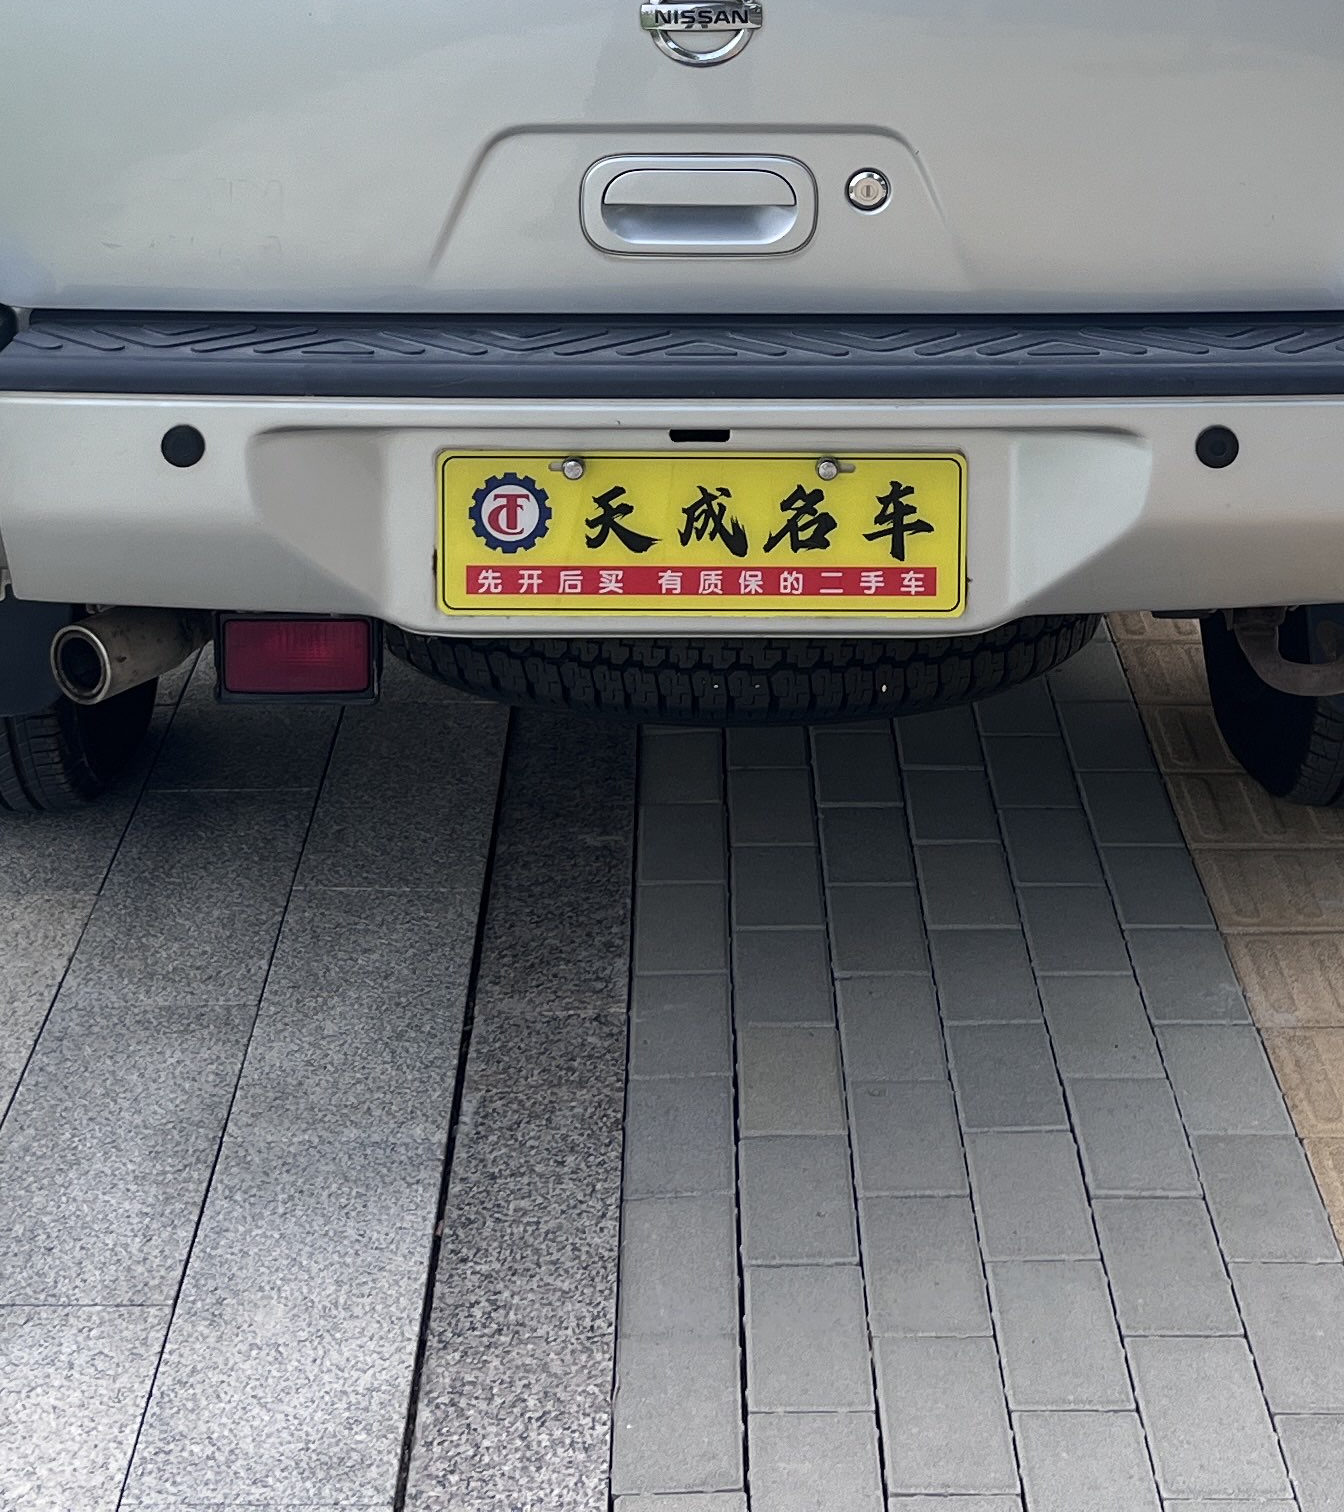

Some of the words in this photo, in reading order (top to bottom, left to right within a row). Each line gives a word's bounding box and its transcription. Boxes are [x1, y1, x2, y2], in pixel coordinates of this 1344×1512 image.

[655, 9, 749, 25] NISSAN
[584, 480, 936, 562] 天成名车
[478, 569, 624, 594] 先开后买
[658, 569, 926, 595] 有质保的二手车
